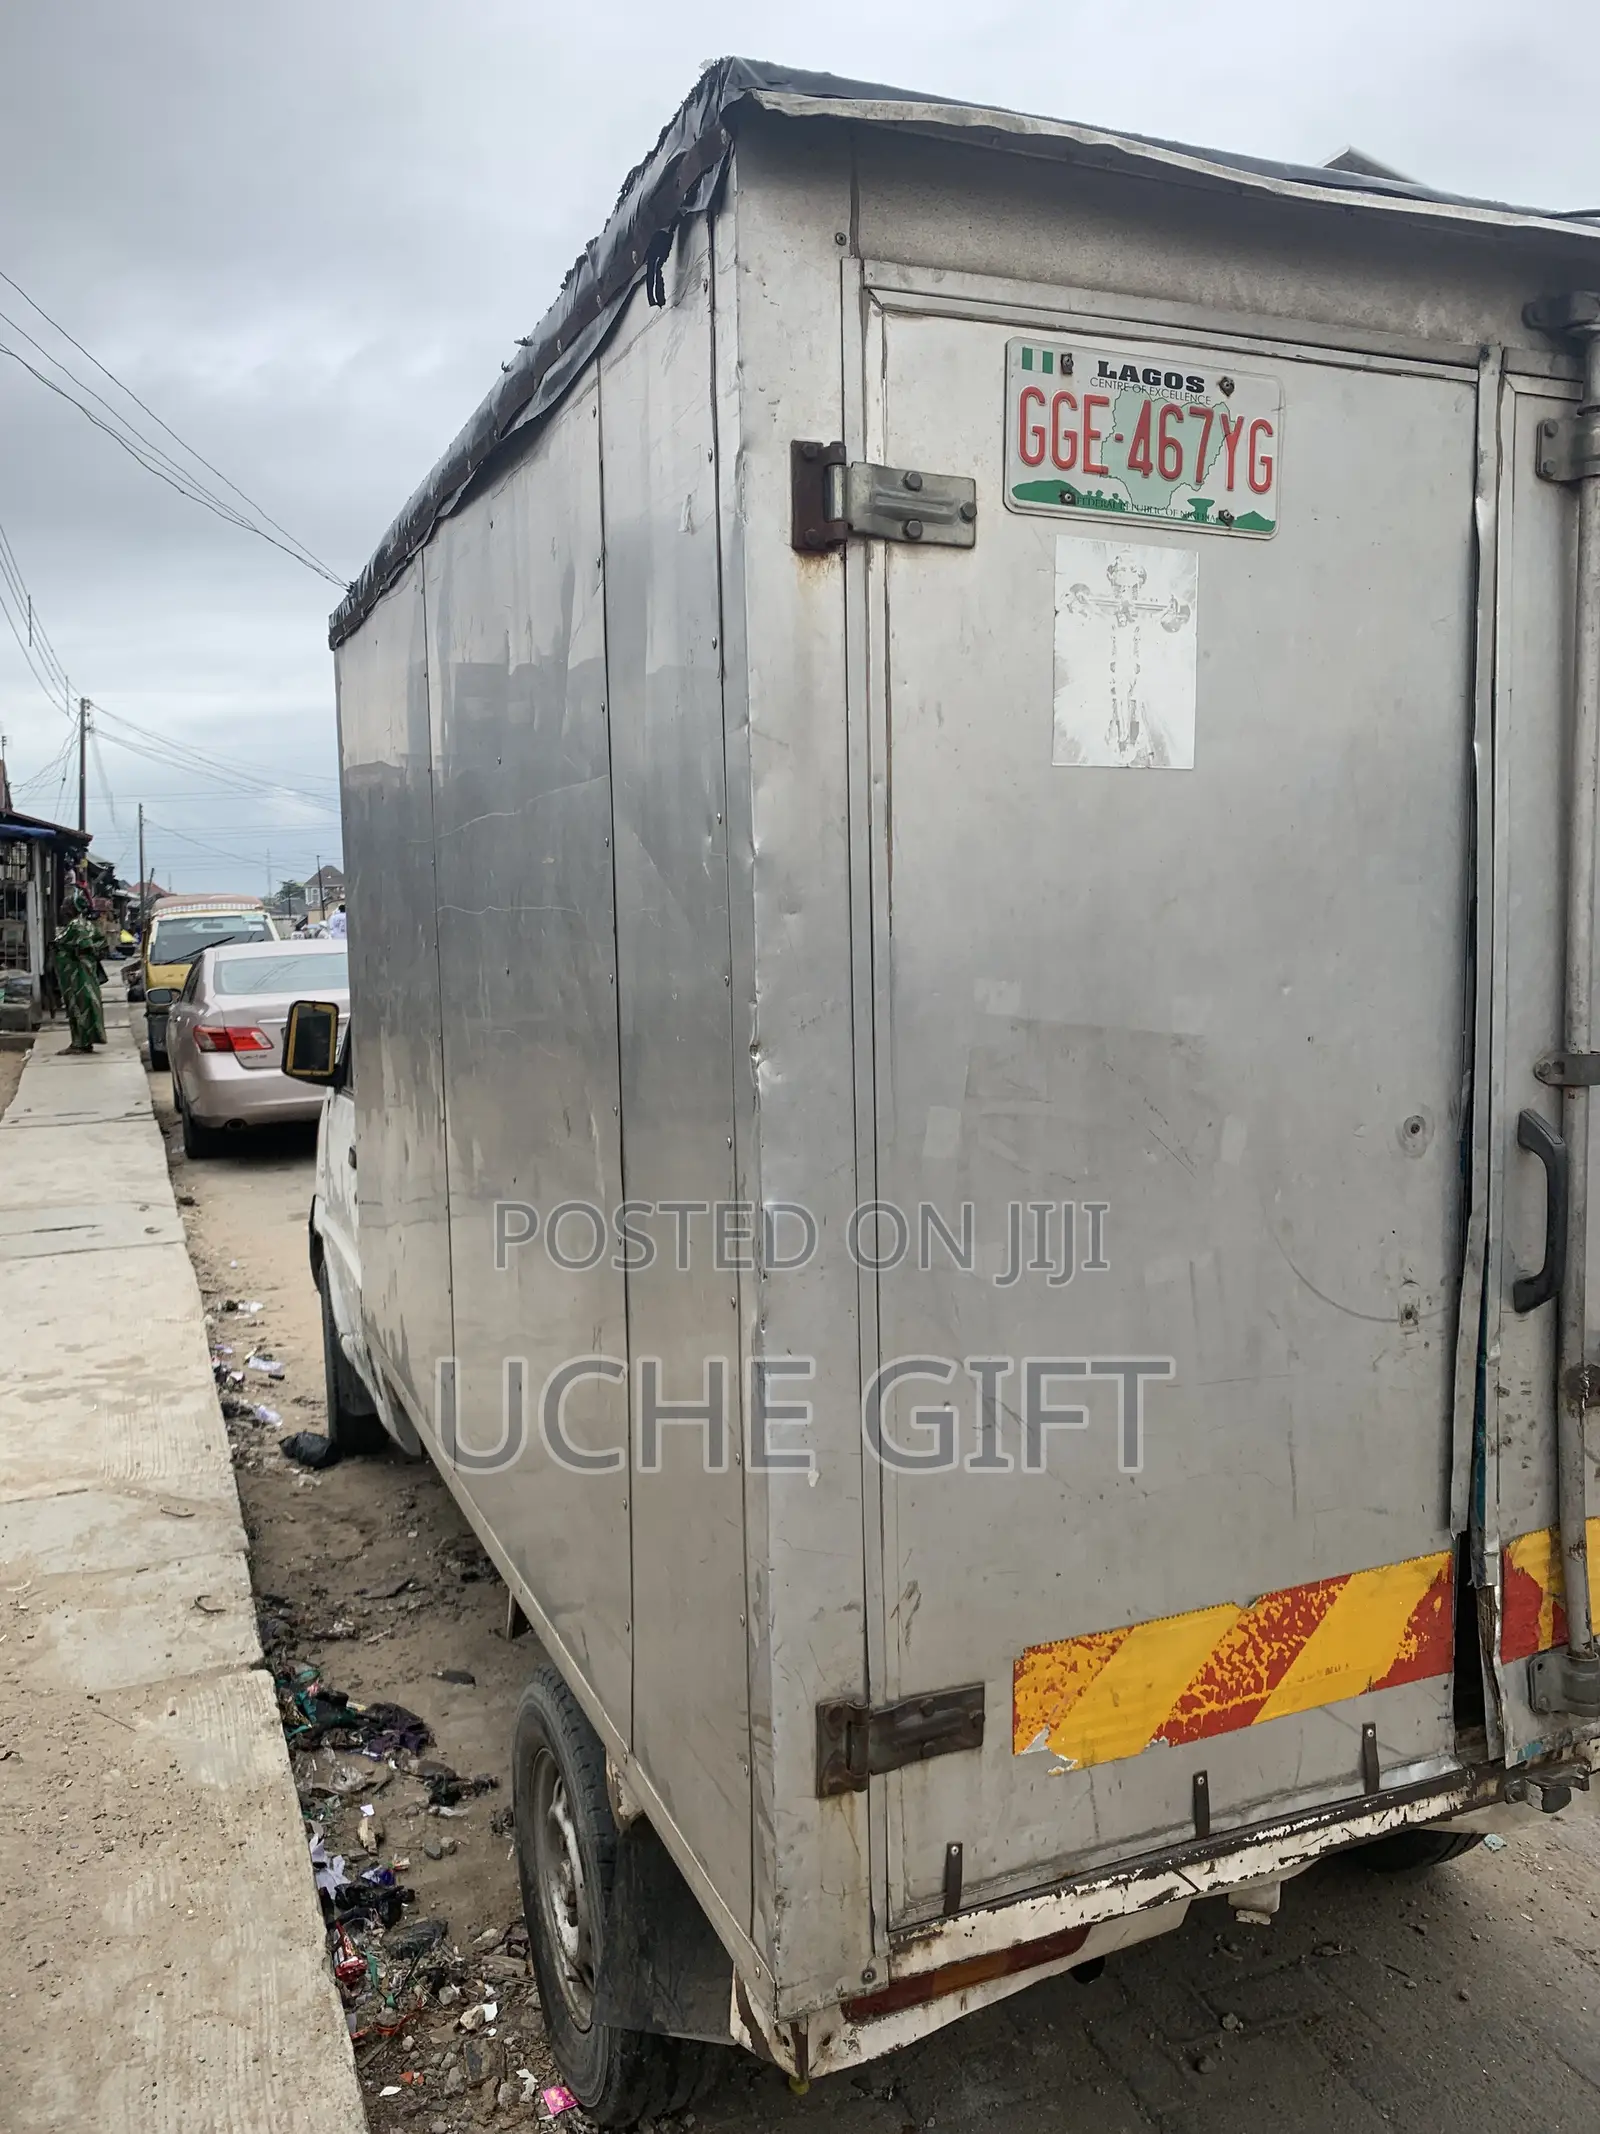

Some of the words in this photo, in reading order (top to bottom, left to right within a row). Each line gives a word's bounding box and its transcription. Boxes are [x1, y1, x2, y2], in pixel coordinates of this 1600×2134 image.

[1090, 377, 1129, 392] CENTRE
[1132, 384, 1147, 394] OF
[1149, 386, 1211, 405] EXCELLENCE
[1097, 360, 1205, 393] LAGOS
[1018, 385, 1274, 494] GGE-467YG
